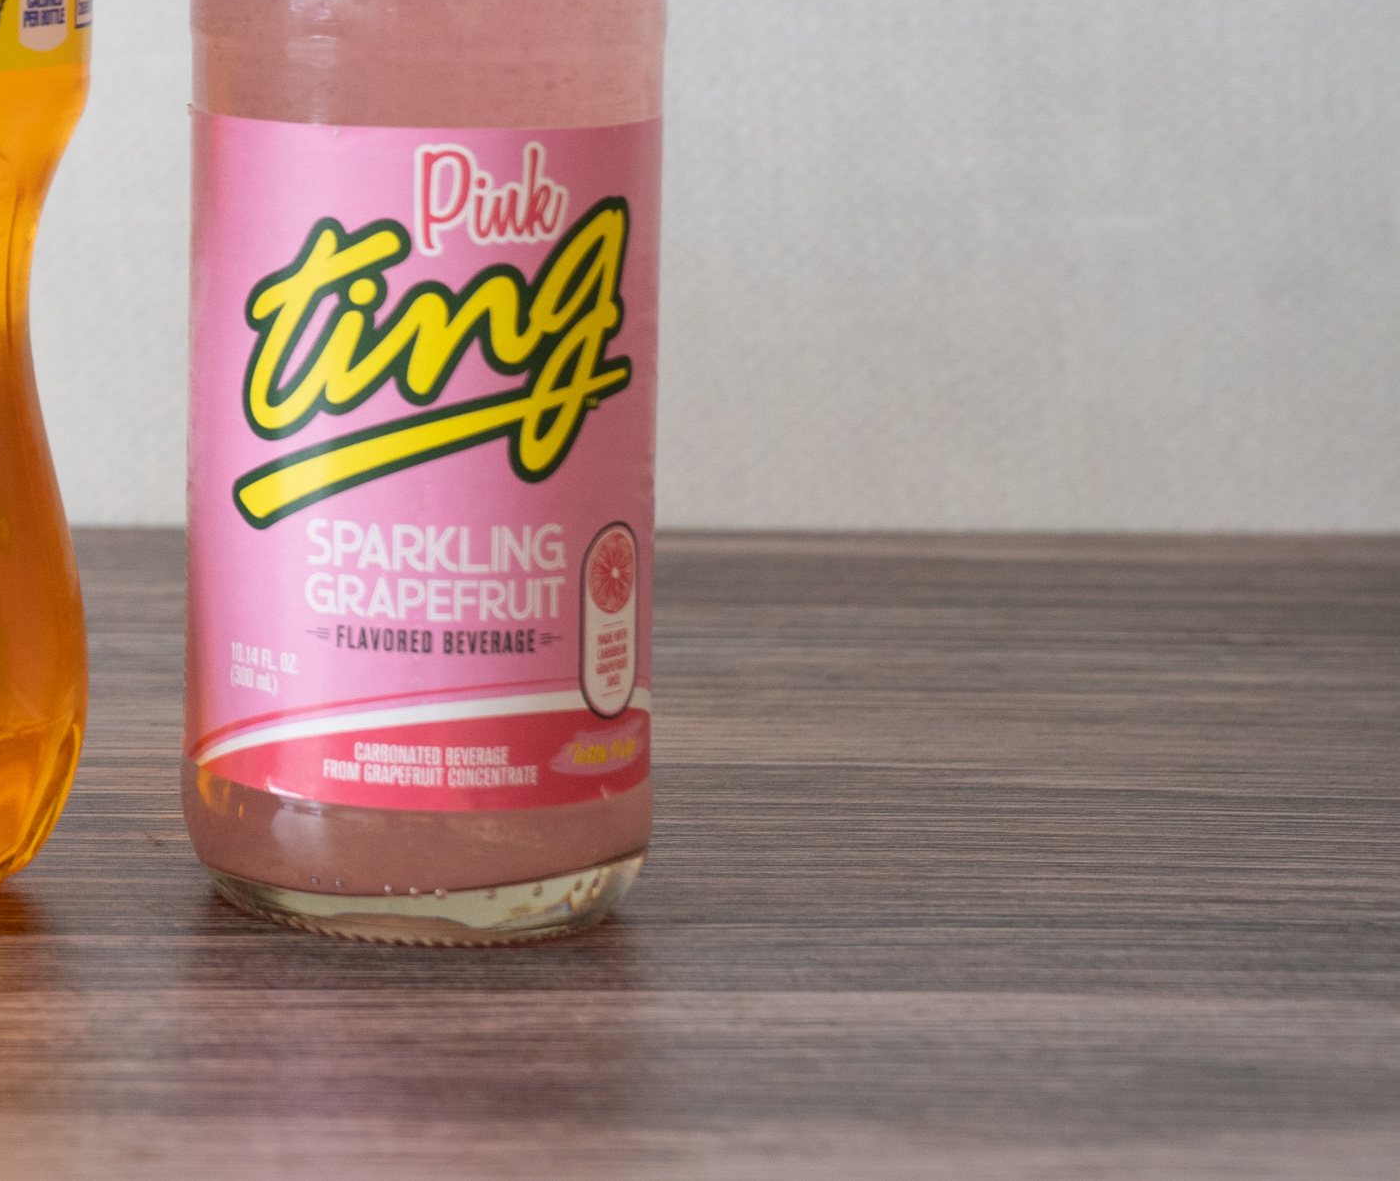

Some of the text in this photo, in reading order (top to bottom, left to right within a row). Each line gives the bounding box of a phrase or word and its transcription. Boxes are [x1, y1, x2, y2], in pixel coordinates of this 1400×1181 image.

[415, 142, 568, 256] Pink
[243, 196, 632, 483] ting
[305, 519, 567, 574] SPARKLING
[304, 572, 566, 623] GRAPEFRUIT
[336, 624, 537, 655] FLAVORED BEVERAGE
[322, 757, 538, 788] FROM GRAPEFRUIT CONCENTRATE
[353, 741, 509, 766] CARBONATED BEVERAGE
